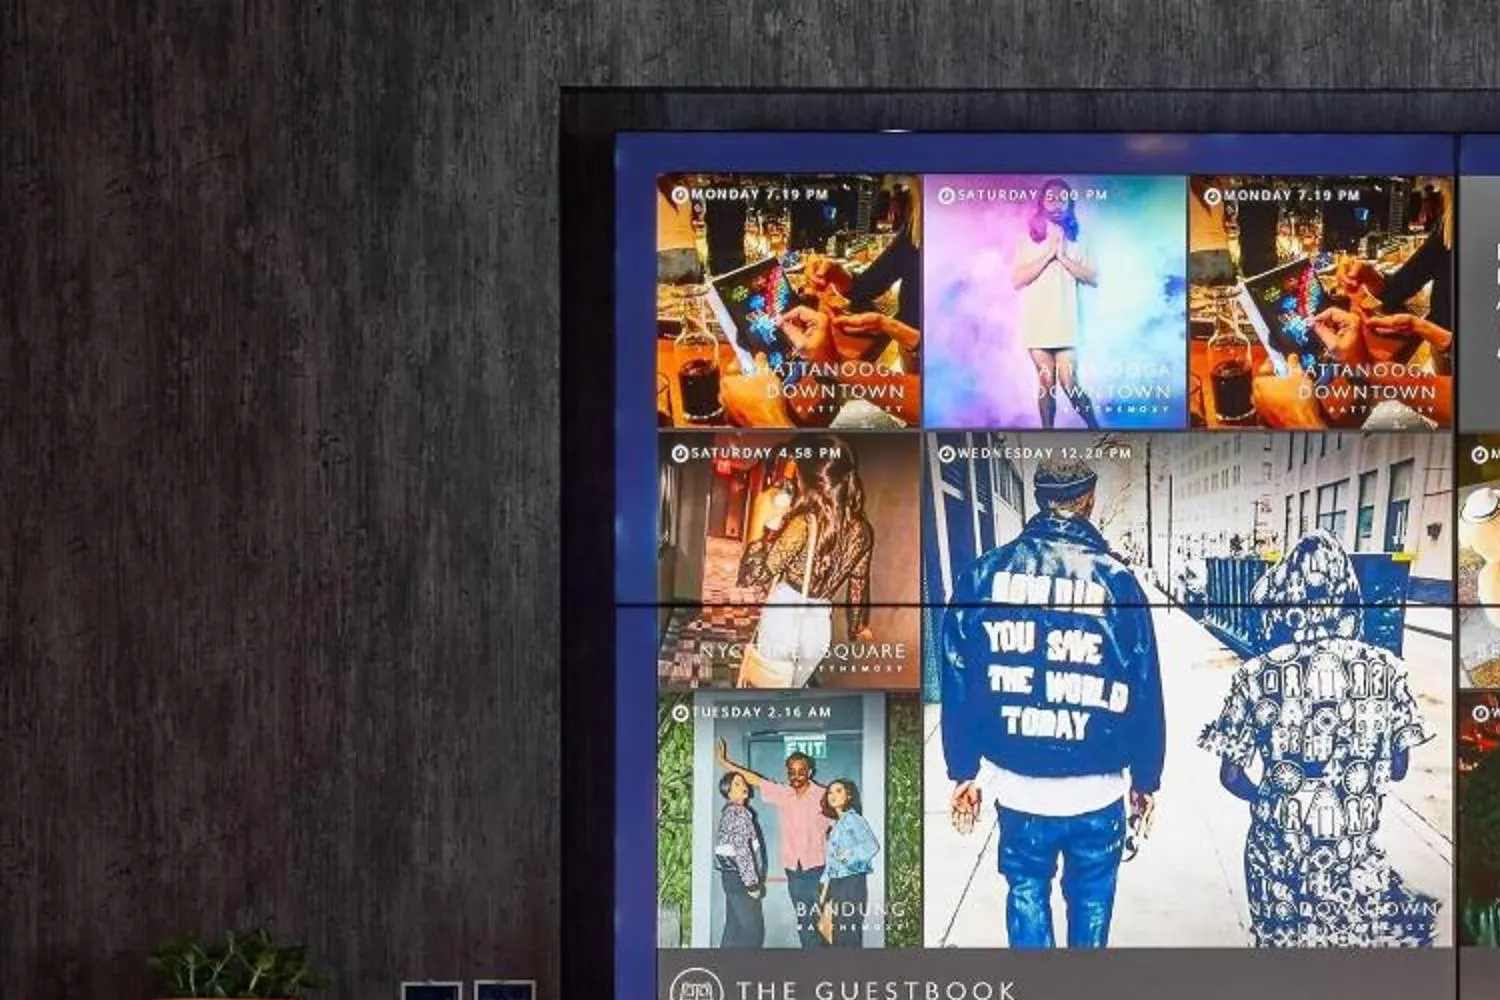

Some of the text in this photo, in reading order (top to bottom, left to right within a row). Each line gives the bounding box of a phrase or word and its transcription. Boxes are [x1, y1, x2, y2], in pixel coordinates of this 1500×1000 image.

[691, 188, 829, 201] MONDAY 7.19 PM
[957, 189, 1108, 201] SATURDAY 5.00 PM
[1225, 189, 1361, 201] MONDAY 7.19 PM
[767, 383, 905, 399] DOWNTOWN
[1298, 384, 1436, 399] DOWNTOWN
[691, 447, 842, 459] SATURDAY 4.58 PM
[957, 447, 1132, 460] WEDNESDAY 12.20 PM
[981, 621, 1036, 653] YOU
[824, 643, 906, 660] SQUARE
[987, 664, 1035, 694] THE
[693, 706, 832, 718] TUESDAY 2.16 AM
[1001, 705, 1091, 741] TODAY
[786, 741, 824, 757] EXIT
